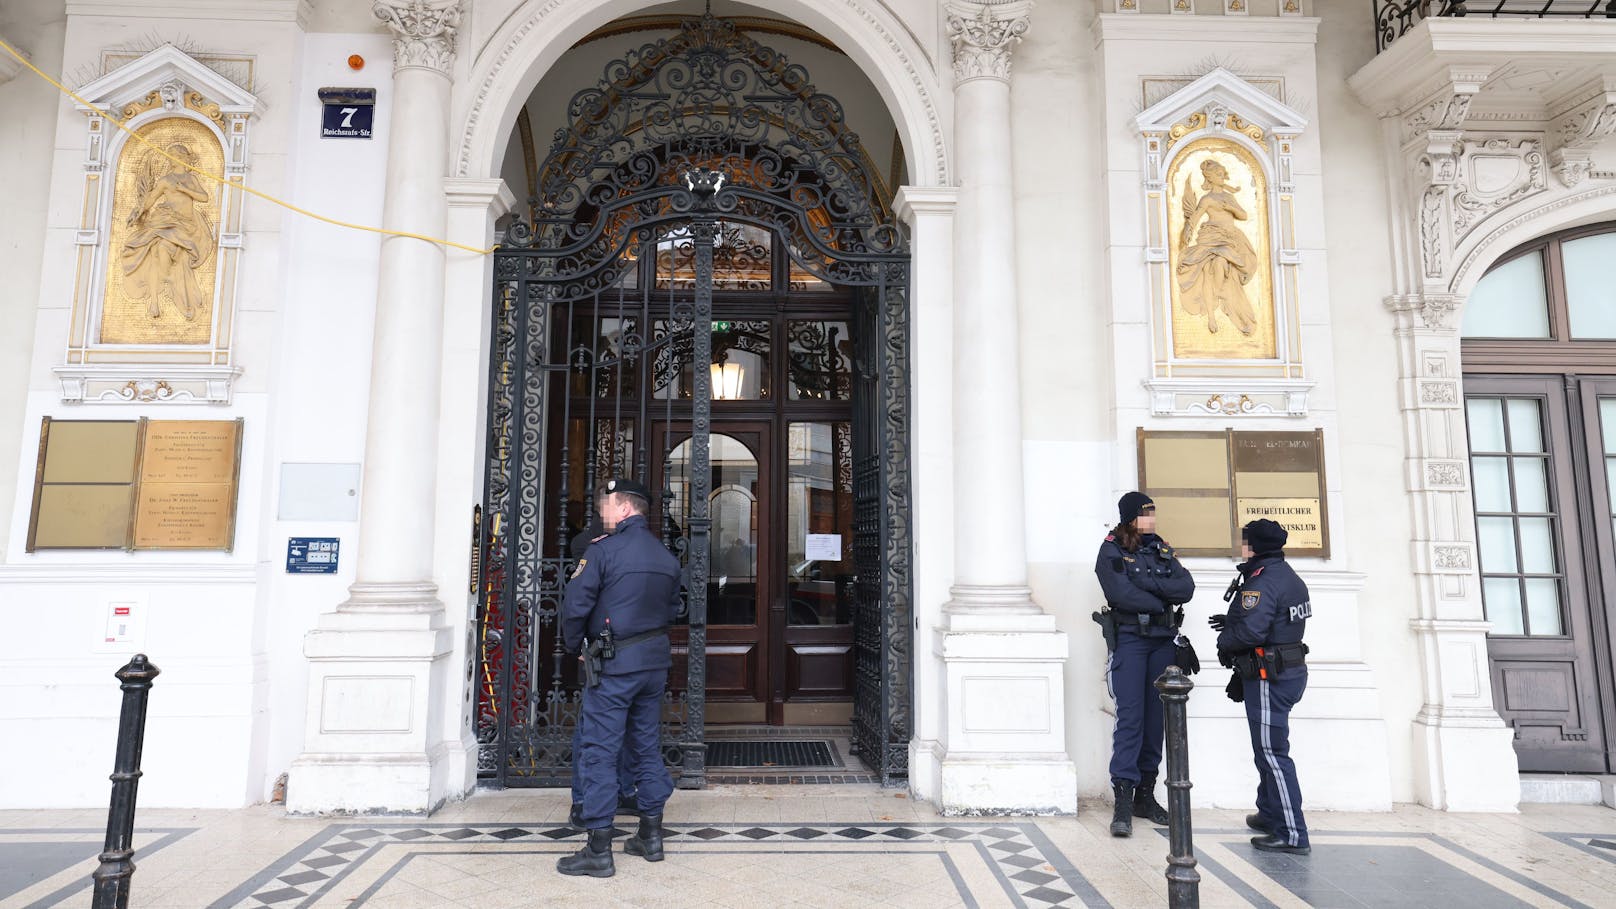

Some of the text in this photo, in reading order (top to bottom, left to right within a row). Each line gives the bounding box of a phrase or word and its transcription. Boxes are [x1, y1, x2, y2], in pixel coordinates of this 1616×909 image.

[340, 107, 358, 127] 7
[1246, 507, 1312, 515] FREIHEITLICHER
[1280, 523, 1317, 531] NTSKLUB
